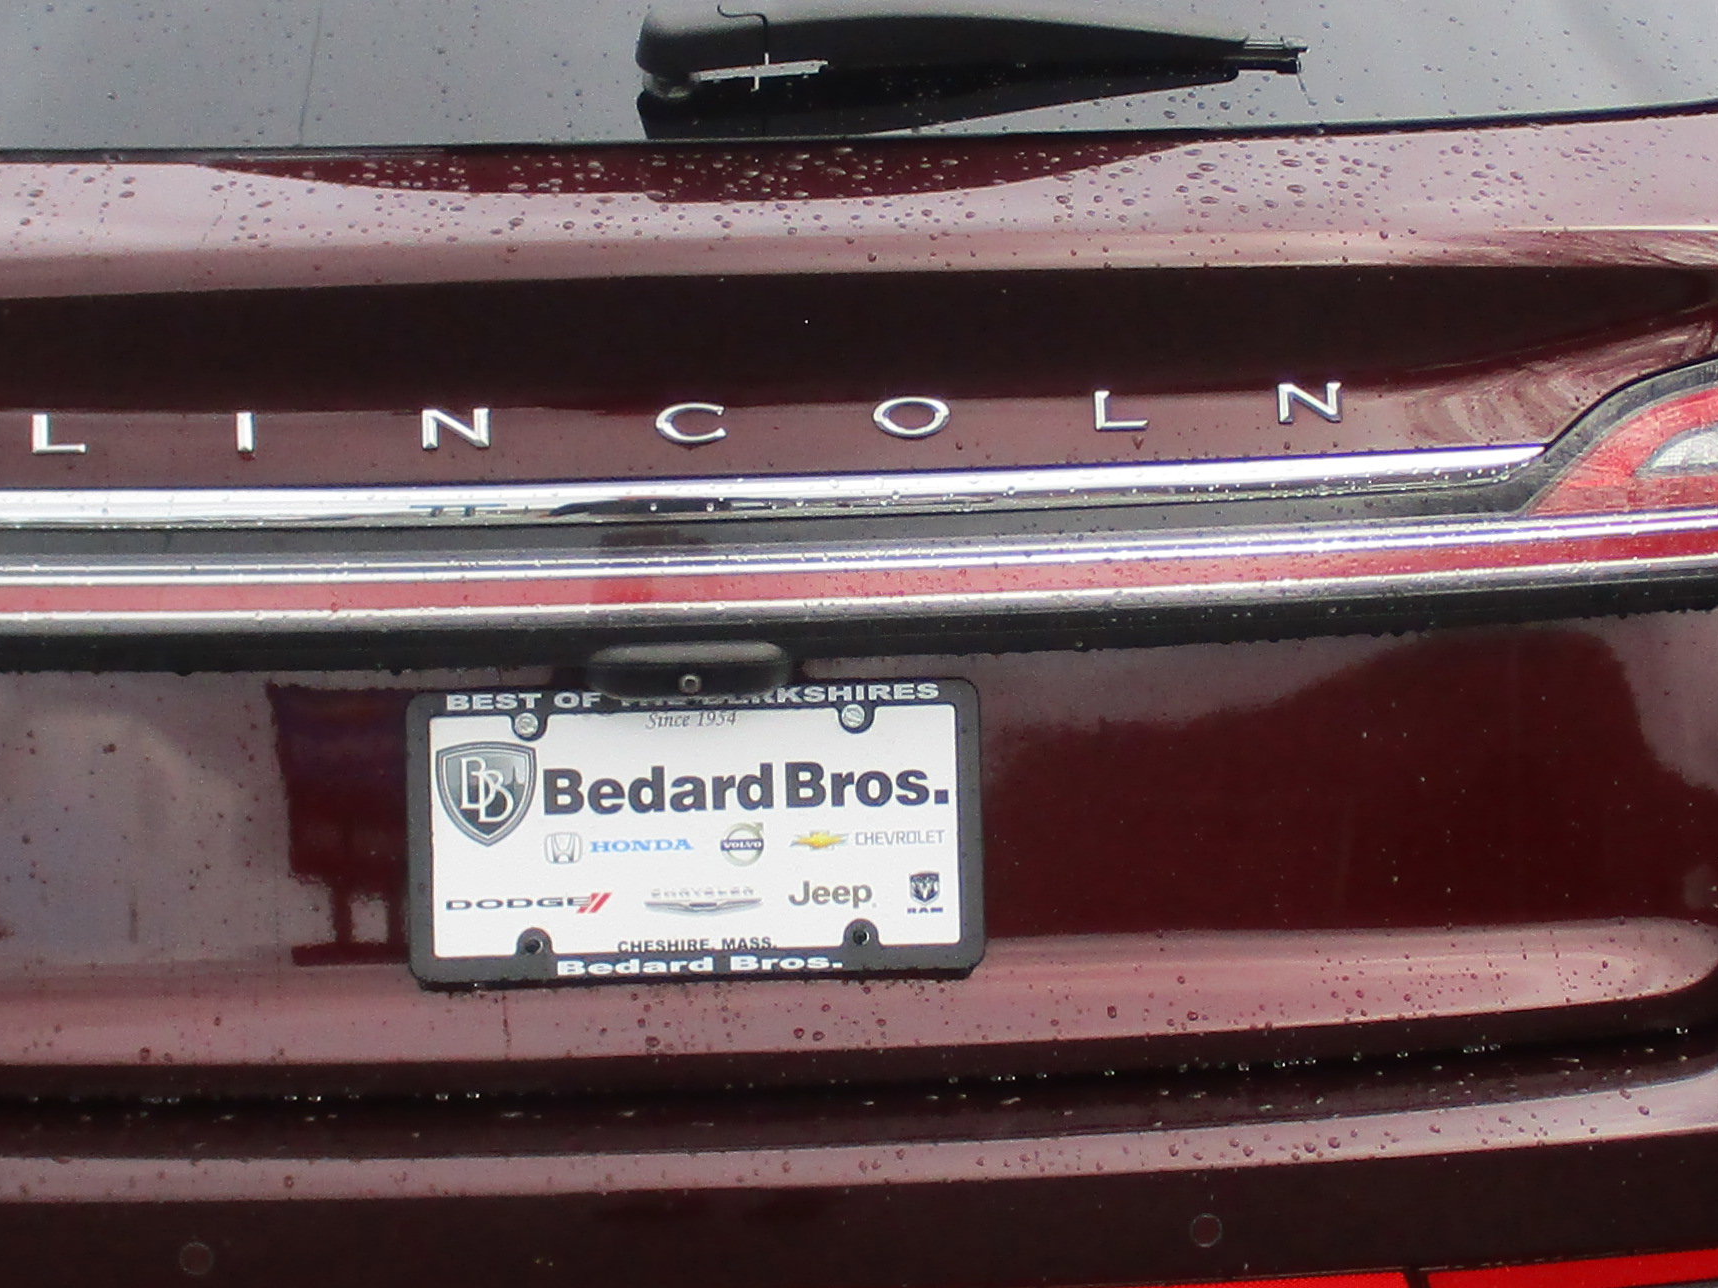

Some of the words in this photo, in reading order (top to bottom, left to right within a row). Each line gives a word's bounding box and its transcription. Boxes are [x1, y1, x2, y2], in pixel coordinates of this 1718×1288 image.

[31, 380, 1342, 455] LINCOLN
[446, 692, 542, 711] BEST
[553, 692, 602, 708] OF
[645, 712, 690, 730] Since
[697, 711, 737, 728] 1954
[589, 838, 694, 853] HONDA
[722, 840, 763, 850] VOLVO
[855, 829, 946, 847] CHEVROLET
[445, 896, 591, 911] DODGE
[788, 880, 873, 909] Jeep
[556, 957, 714, 977] Bedard
[730, 954, 843, 972] Bros.
